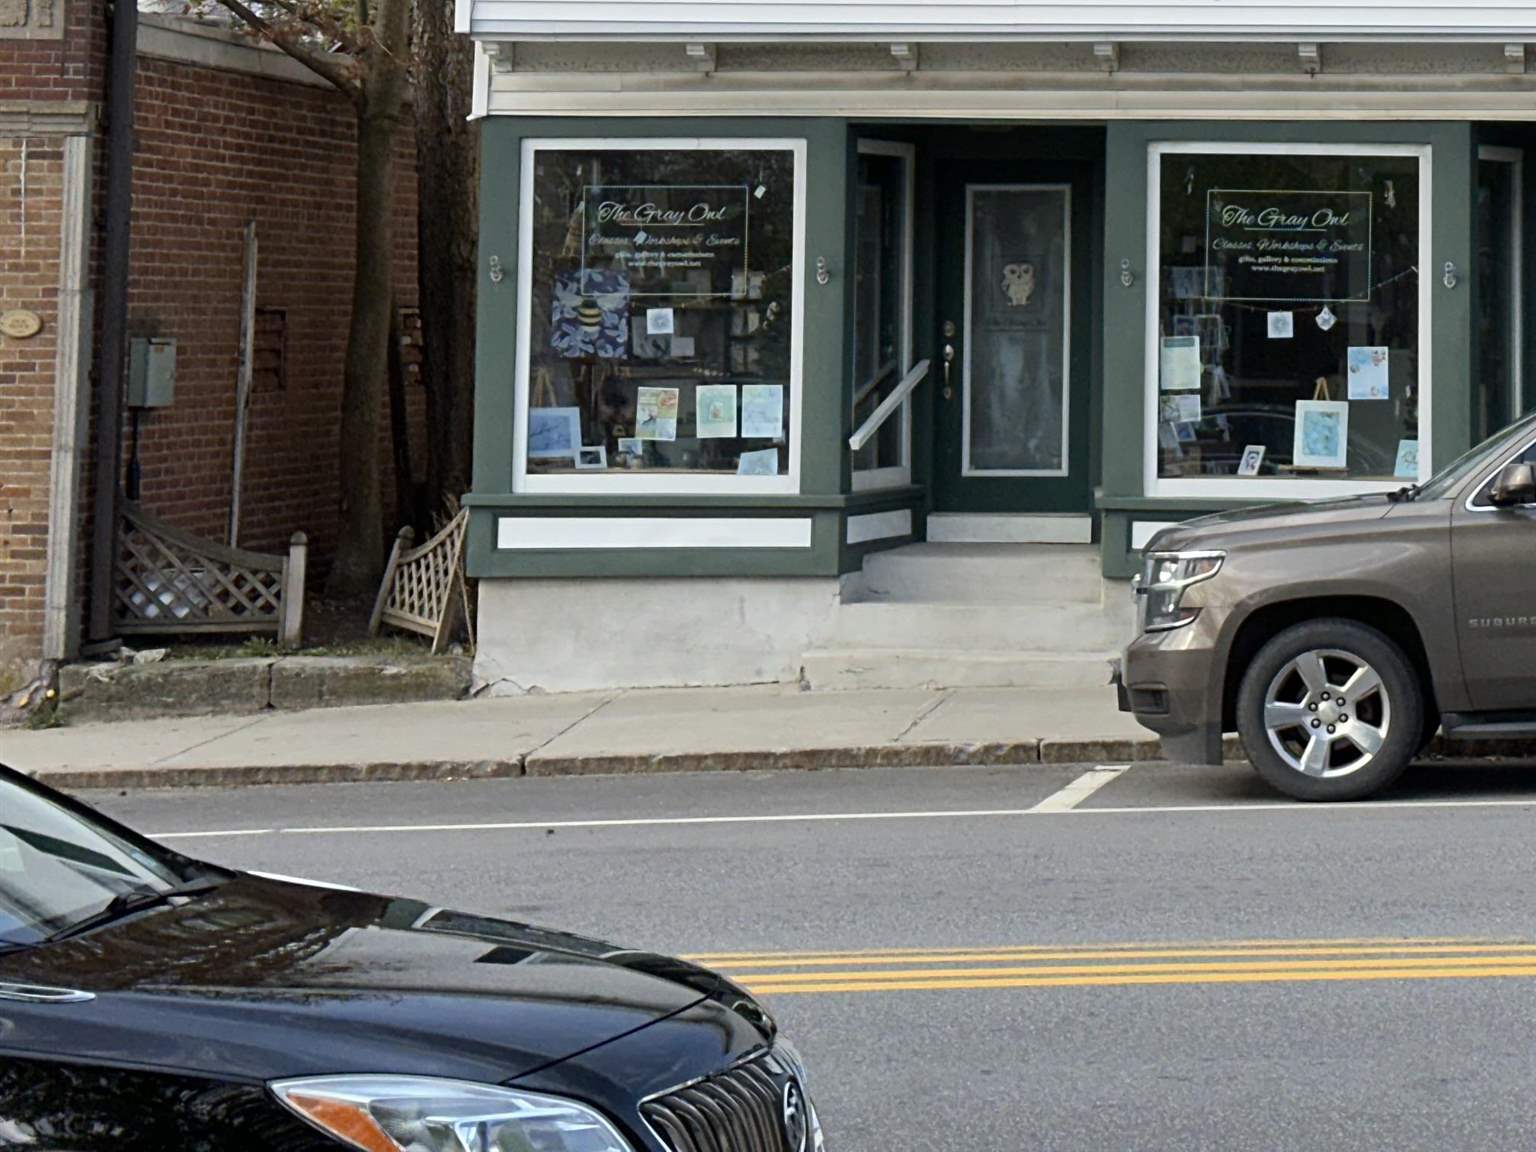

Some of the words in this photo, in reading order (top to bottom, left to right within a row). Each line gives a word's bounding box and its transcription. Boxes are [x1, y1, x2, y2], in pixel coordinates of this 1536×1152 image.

[597, 201, 632, 223] The
[634, 203, 685, 225] Gray
[688, 203, 727, 222] Owl
[1222, 204, 1256, 227] The
[1257, 207, 1309, 230] Gray
[1311, 208, 1350, 227] Owl
[1256, 237, 1314, 252] Workshops
[1316, 238, 1328, 251] &
[1329, 238, 1364, 252] Events
[1258, 255, 1282, 264] gallery
